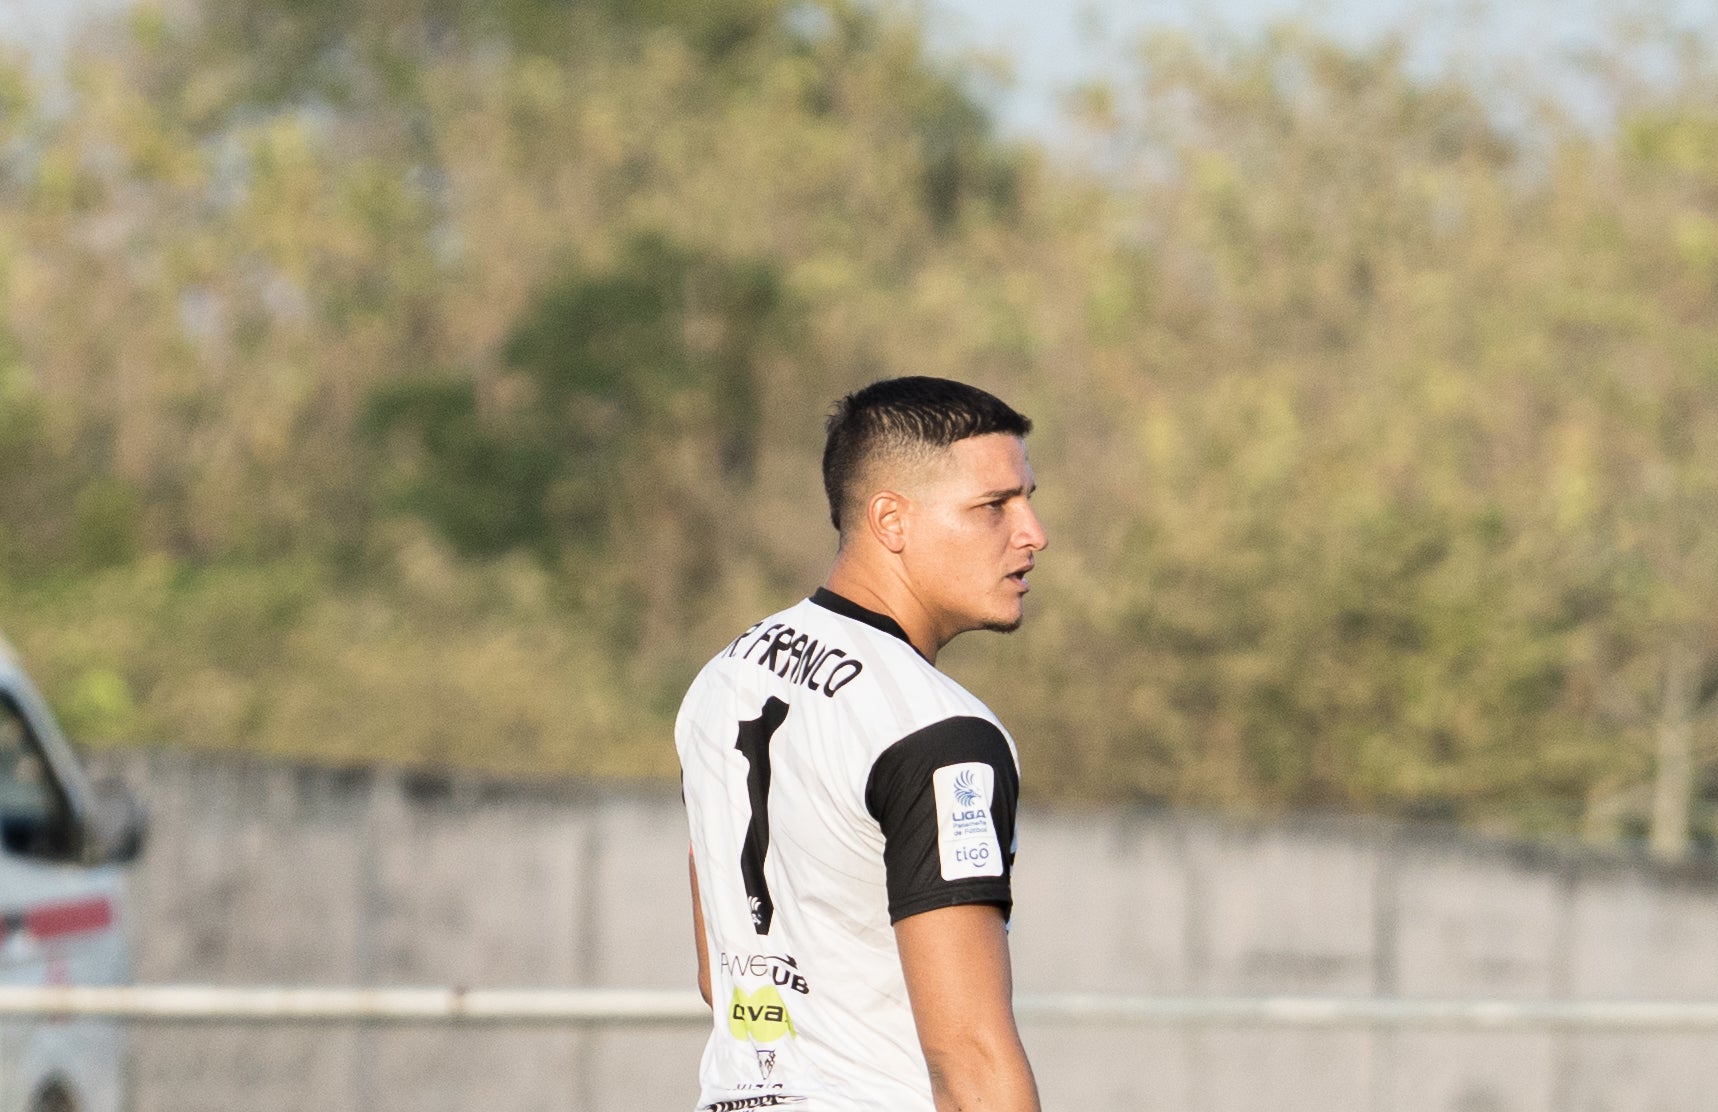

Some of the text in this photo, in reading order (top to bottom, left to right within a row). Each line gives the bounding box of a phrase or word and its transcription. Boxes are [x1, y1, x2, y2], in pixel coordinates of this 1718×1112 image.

[743, 623, 863, 698] FRANCO
[734, 696, 790, 935] 1
[952, 809, 987, 821] LIGA
